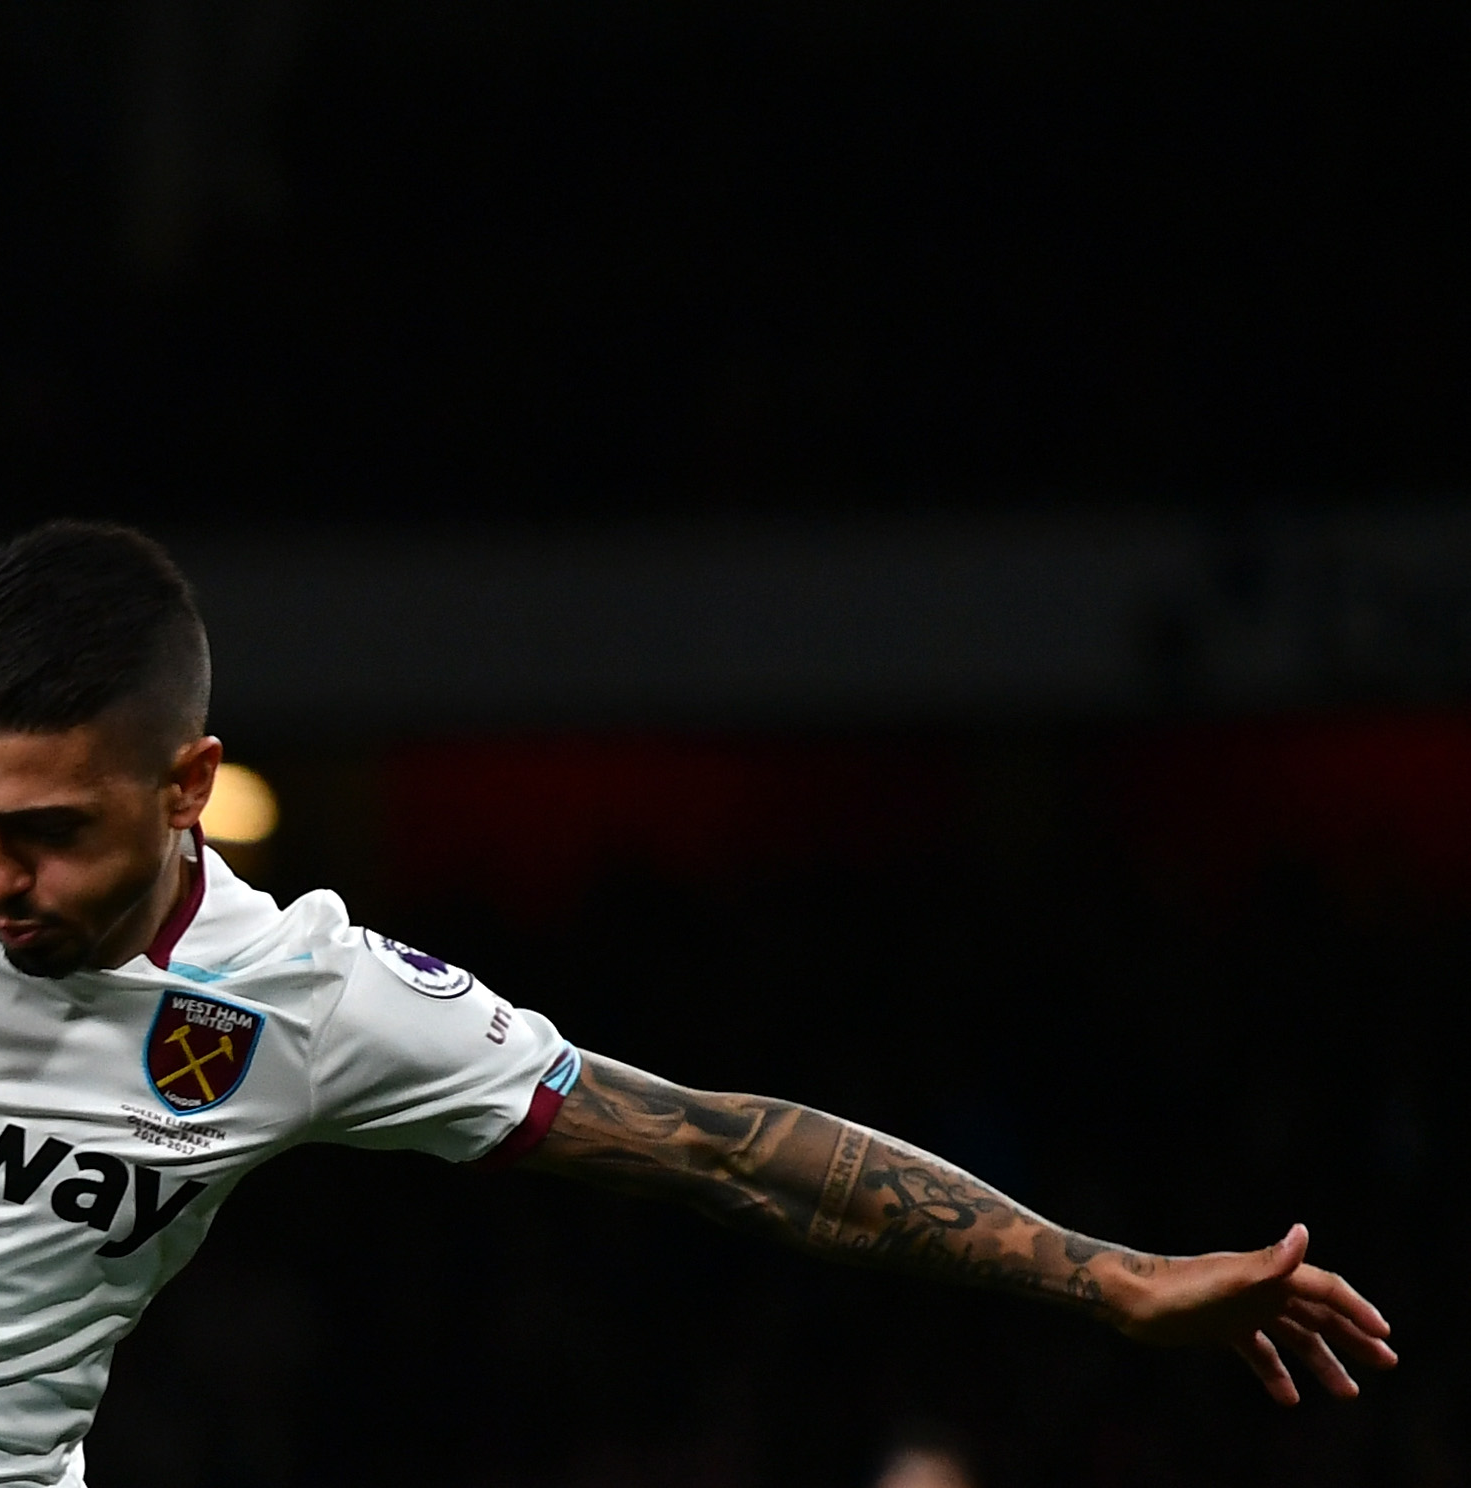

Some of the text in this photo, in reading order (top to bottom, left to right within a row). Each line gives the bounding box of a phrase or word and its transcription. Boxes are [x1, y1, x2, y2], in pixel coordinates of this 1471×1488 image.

[171, 996, 254, 1030] WEST HAM
[185, 1010, 235, 1034] UNITED
[131, 1127, 196, 1156] 2016-2017
